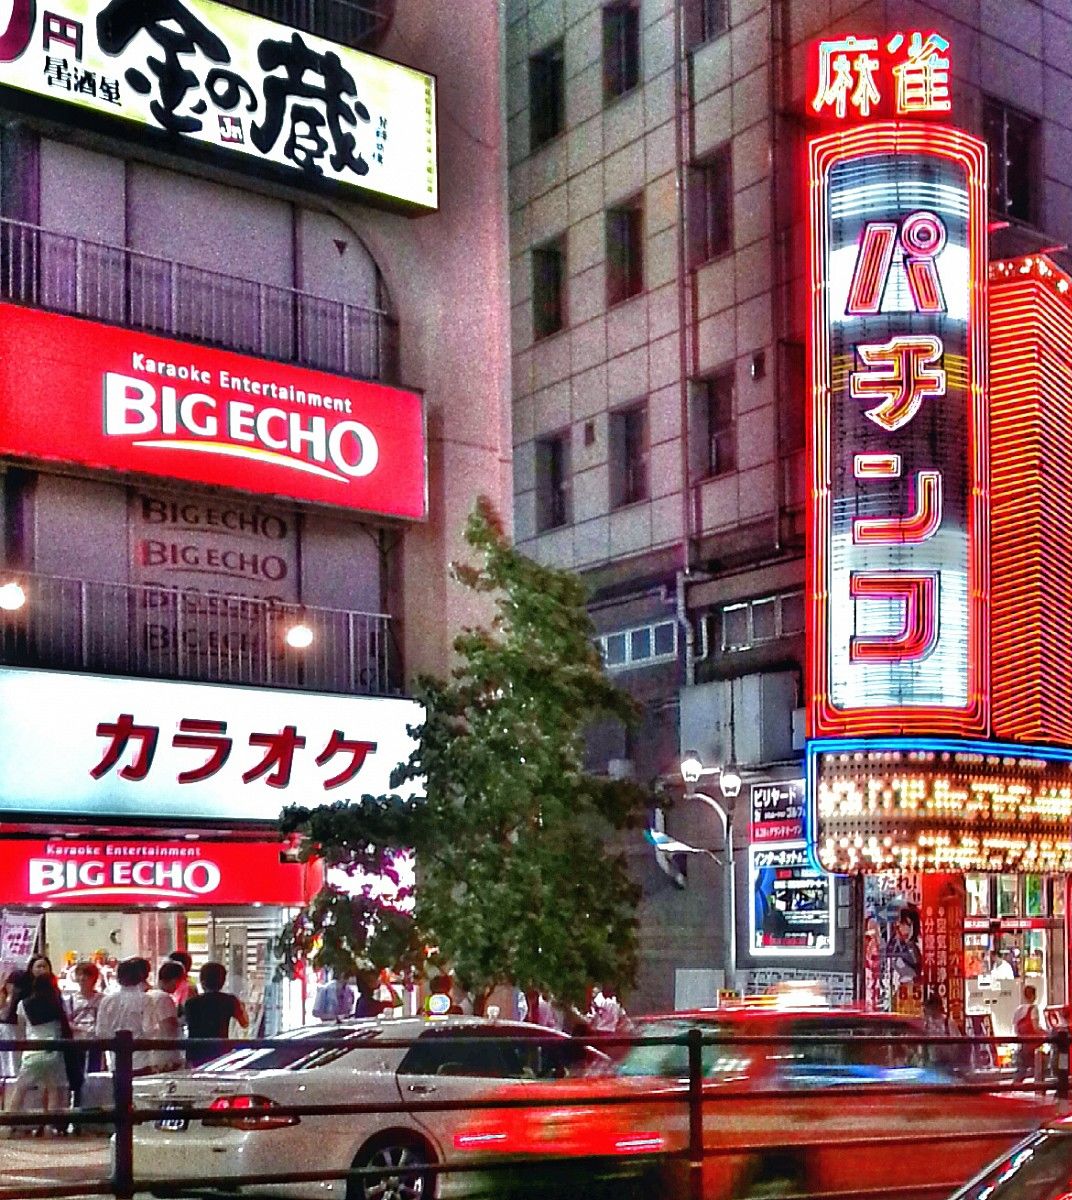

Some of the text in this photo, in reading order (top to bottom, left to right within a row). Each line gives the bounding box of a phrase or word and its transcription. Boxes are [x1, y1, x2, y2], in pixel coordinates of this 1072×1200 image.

[44, 55, 122, 106] 居酒屋
[97, 0, 371, 176] 金の蔵
[812, 33, 951, 119] 麻雀
[132, 351, 353, 414] Karaoke Entertainment
[103, 371, 380, 478] BIG ECHO
[844, 210, 949, 665] パチンコ
[141, 500, 289, 541] BIG ECHO
[141, 540, 289, 582] BIG ECHO
[89, 713, 378, 791] カラオケ
[754, 787, 796, 807] ビリヤード
[29, 858, 221, 895] BIG ECHO
[46, 844, 200, 857] Karaoke Entertainment
